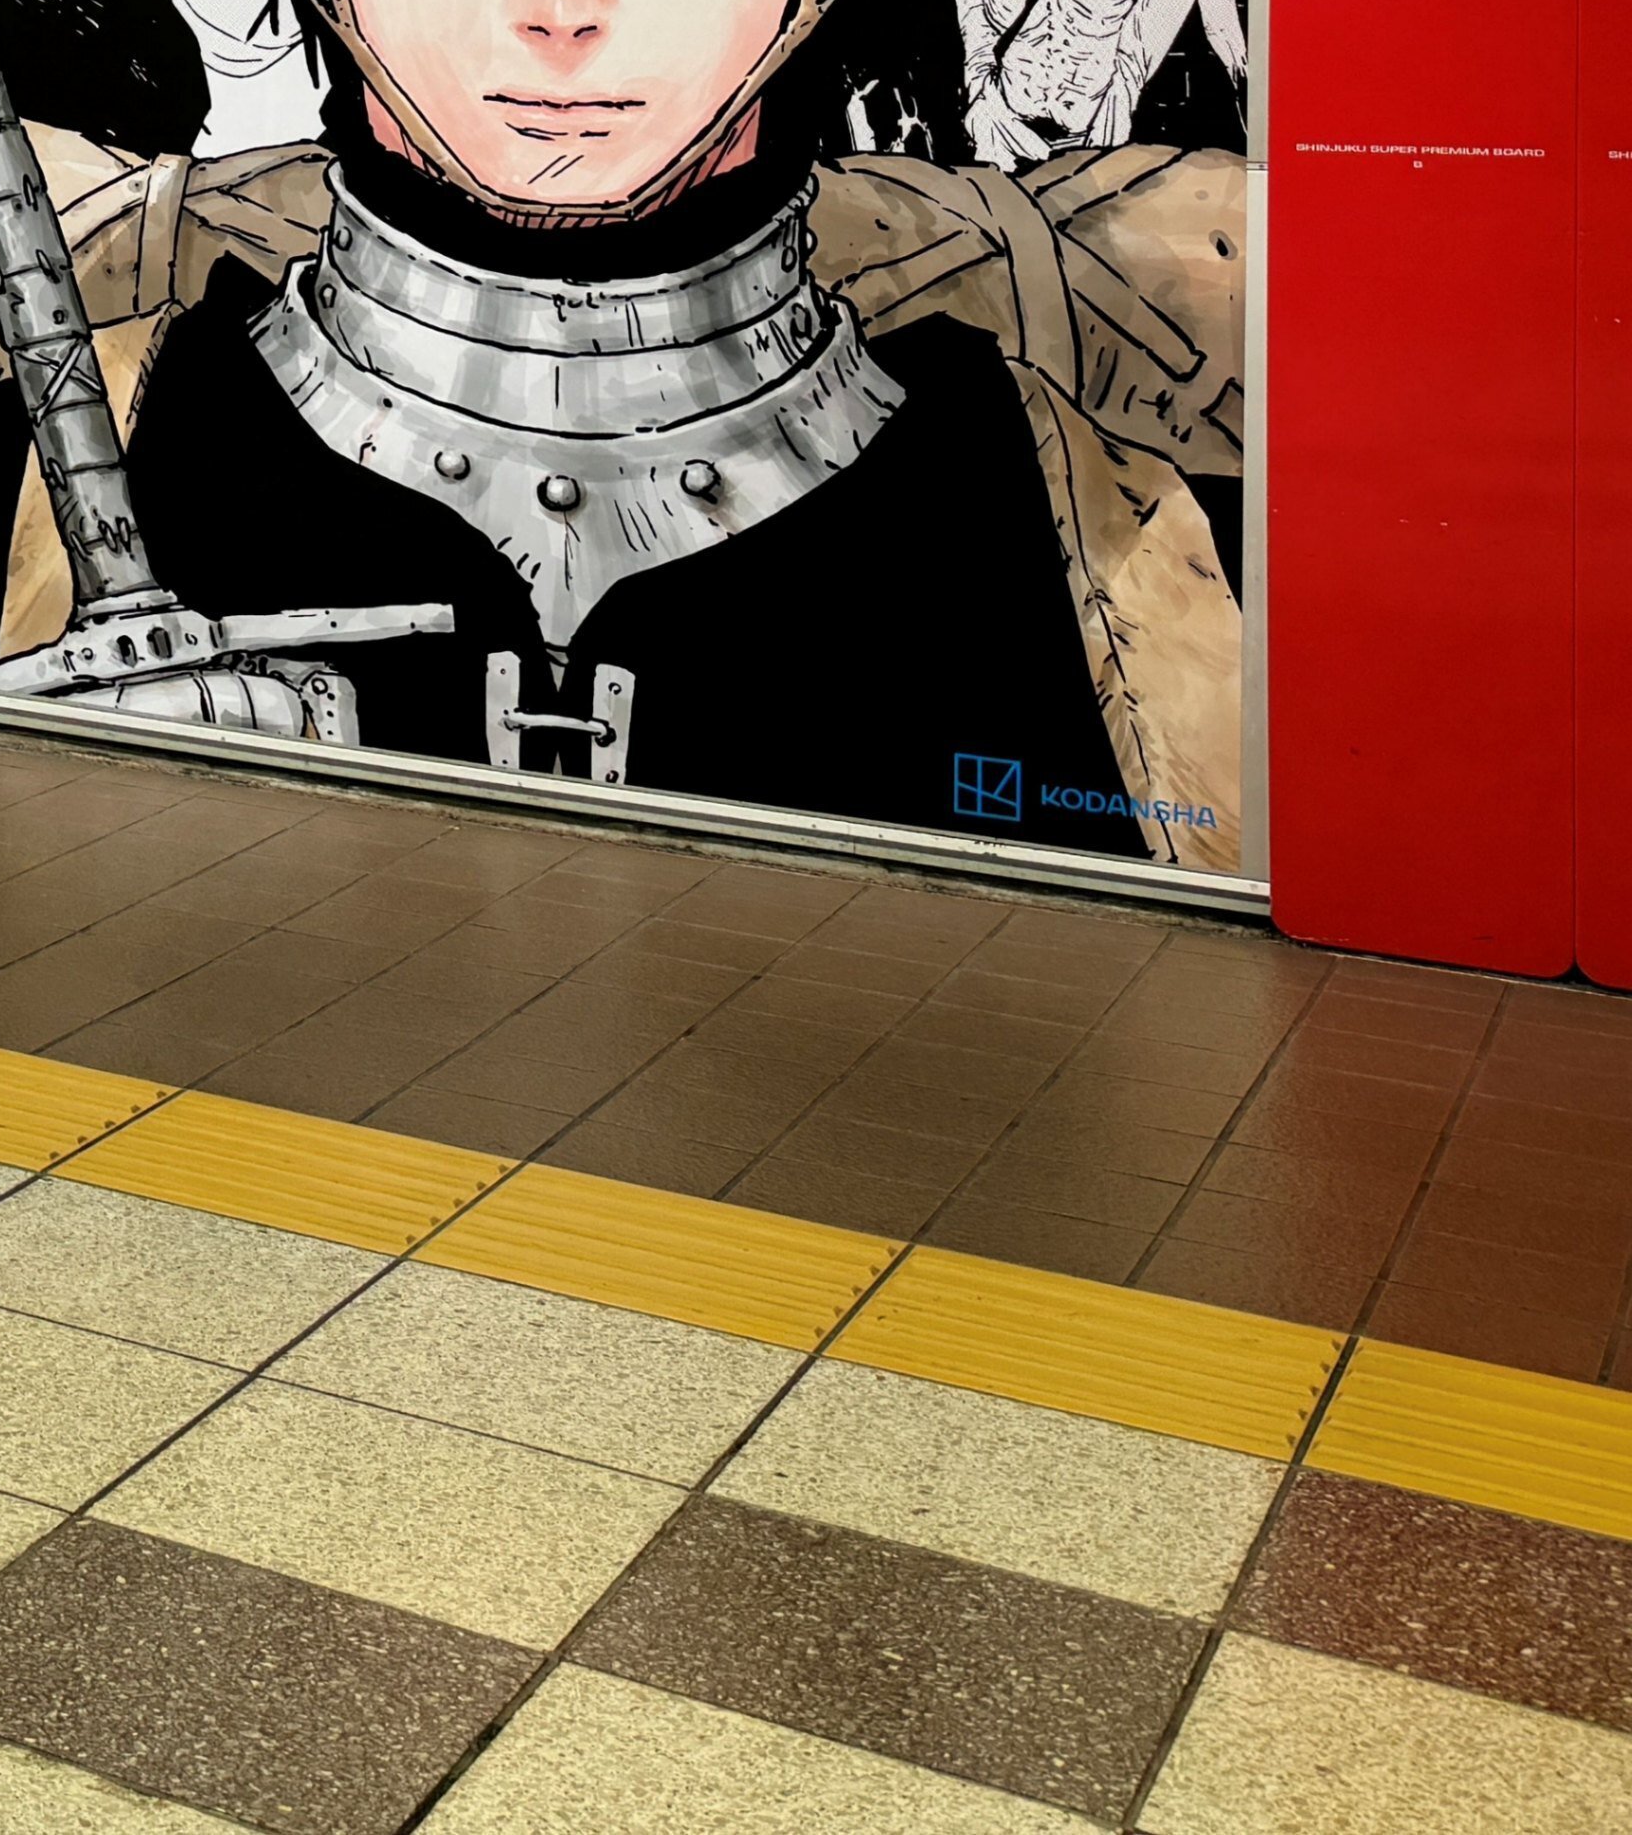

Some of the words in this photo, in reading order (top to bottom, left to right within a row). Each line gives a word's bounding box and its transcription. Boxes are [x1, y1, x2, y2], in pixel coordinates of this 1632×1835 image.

[1296, 143, 1367, 153] SHINJUKU
[1370, 144, 1418, 154] SUPER
[1421, 145, 1490, 156] PREMIUM
[1493, 147, 1546, 157] BOARD
[1040, 783, 1218, 829] KODANSHA
